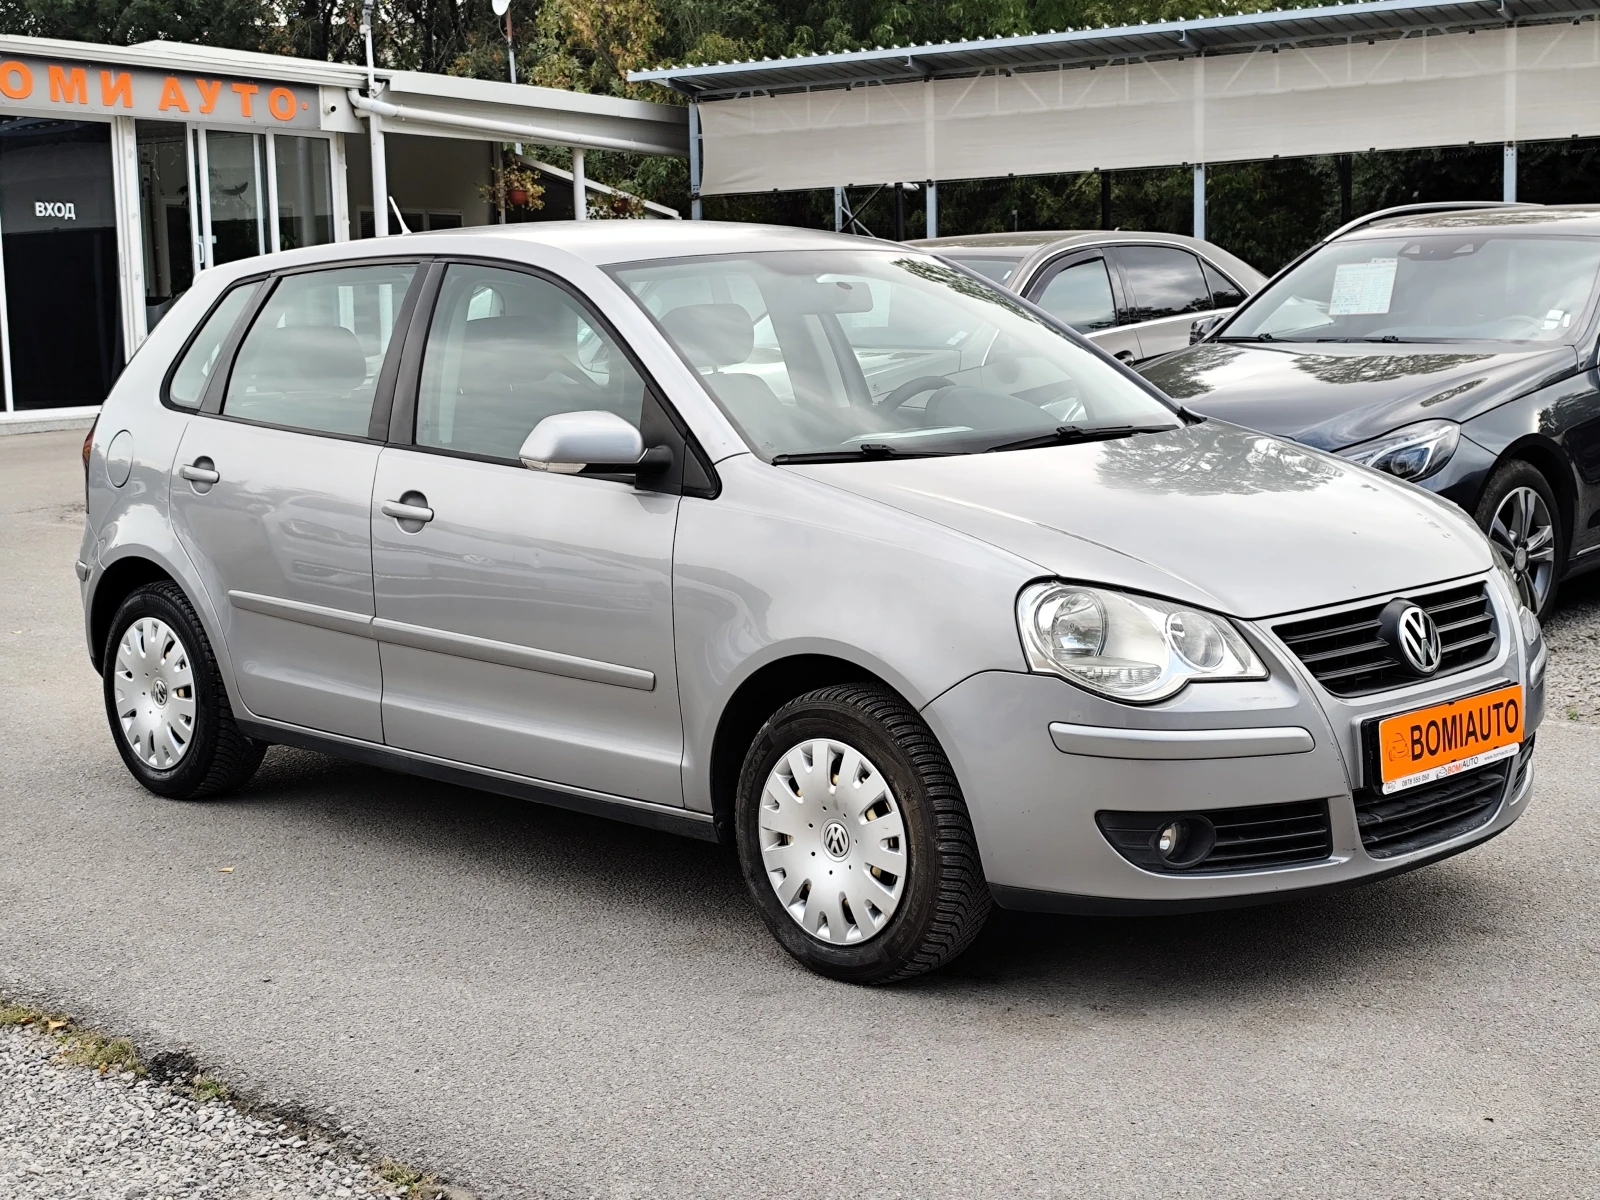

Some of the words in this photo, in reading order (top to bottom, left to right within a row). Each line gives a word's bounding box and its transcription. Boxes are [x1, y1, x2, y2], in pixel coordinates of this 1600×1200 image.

[158, 77, 297, 121] АУТО
[35, 201, 76, 221] ВХОД
[1410, 698, 1519, 762] BOMIAUTO
[1447, 756, 1479, 775] BOMIAUTO
